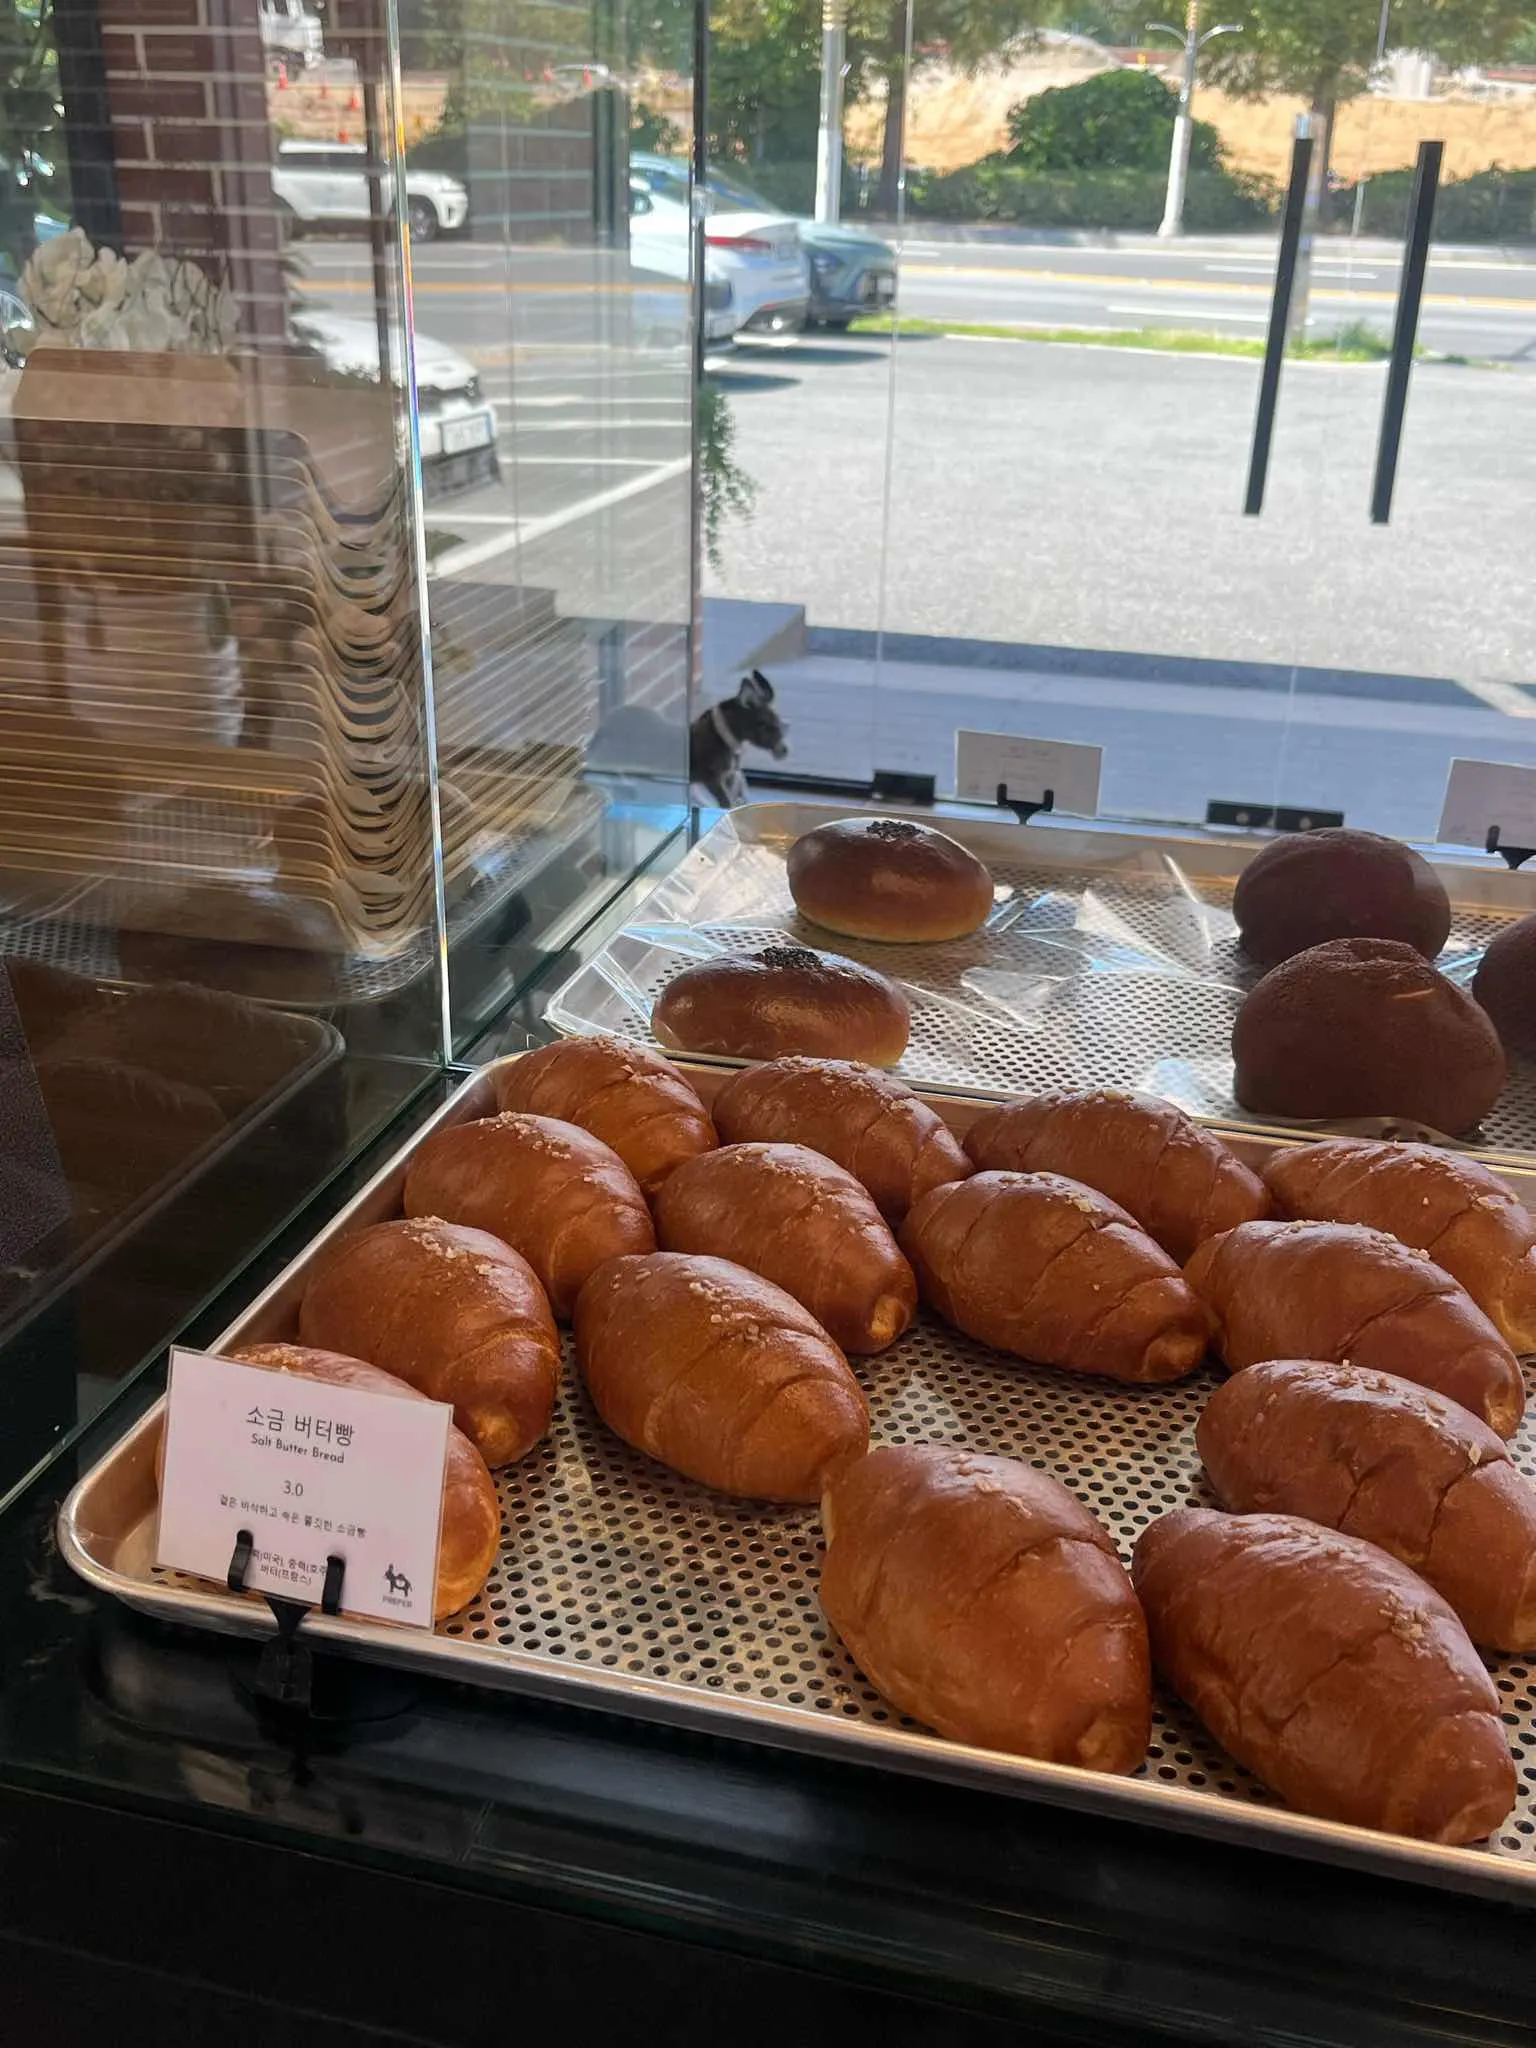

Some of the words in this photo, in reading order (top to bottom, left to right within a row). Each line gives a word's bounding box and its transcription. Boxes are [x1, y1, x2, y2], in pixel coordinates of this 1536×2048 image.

[246, 1406, 285, 1432] 소금
[295, 1415, 355, 1446] 버터빵
[251, 1433, 271, 1448] Salt
[276, 1438, 308, 1456] Butter
[312, 1446, 345, 1464] Bread
[283, 1480, 304, 1497] 3.0
[336, 1523, 367, 1538] 소금빵
